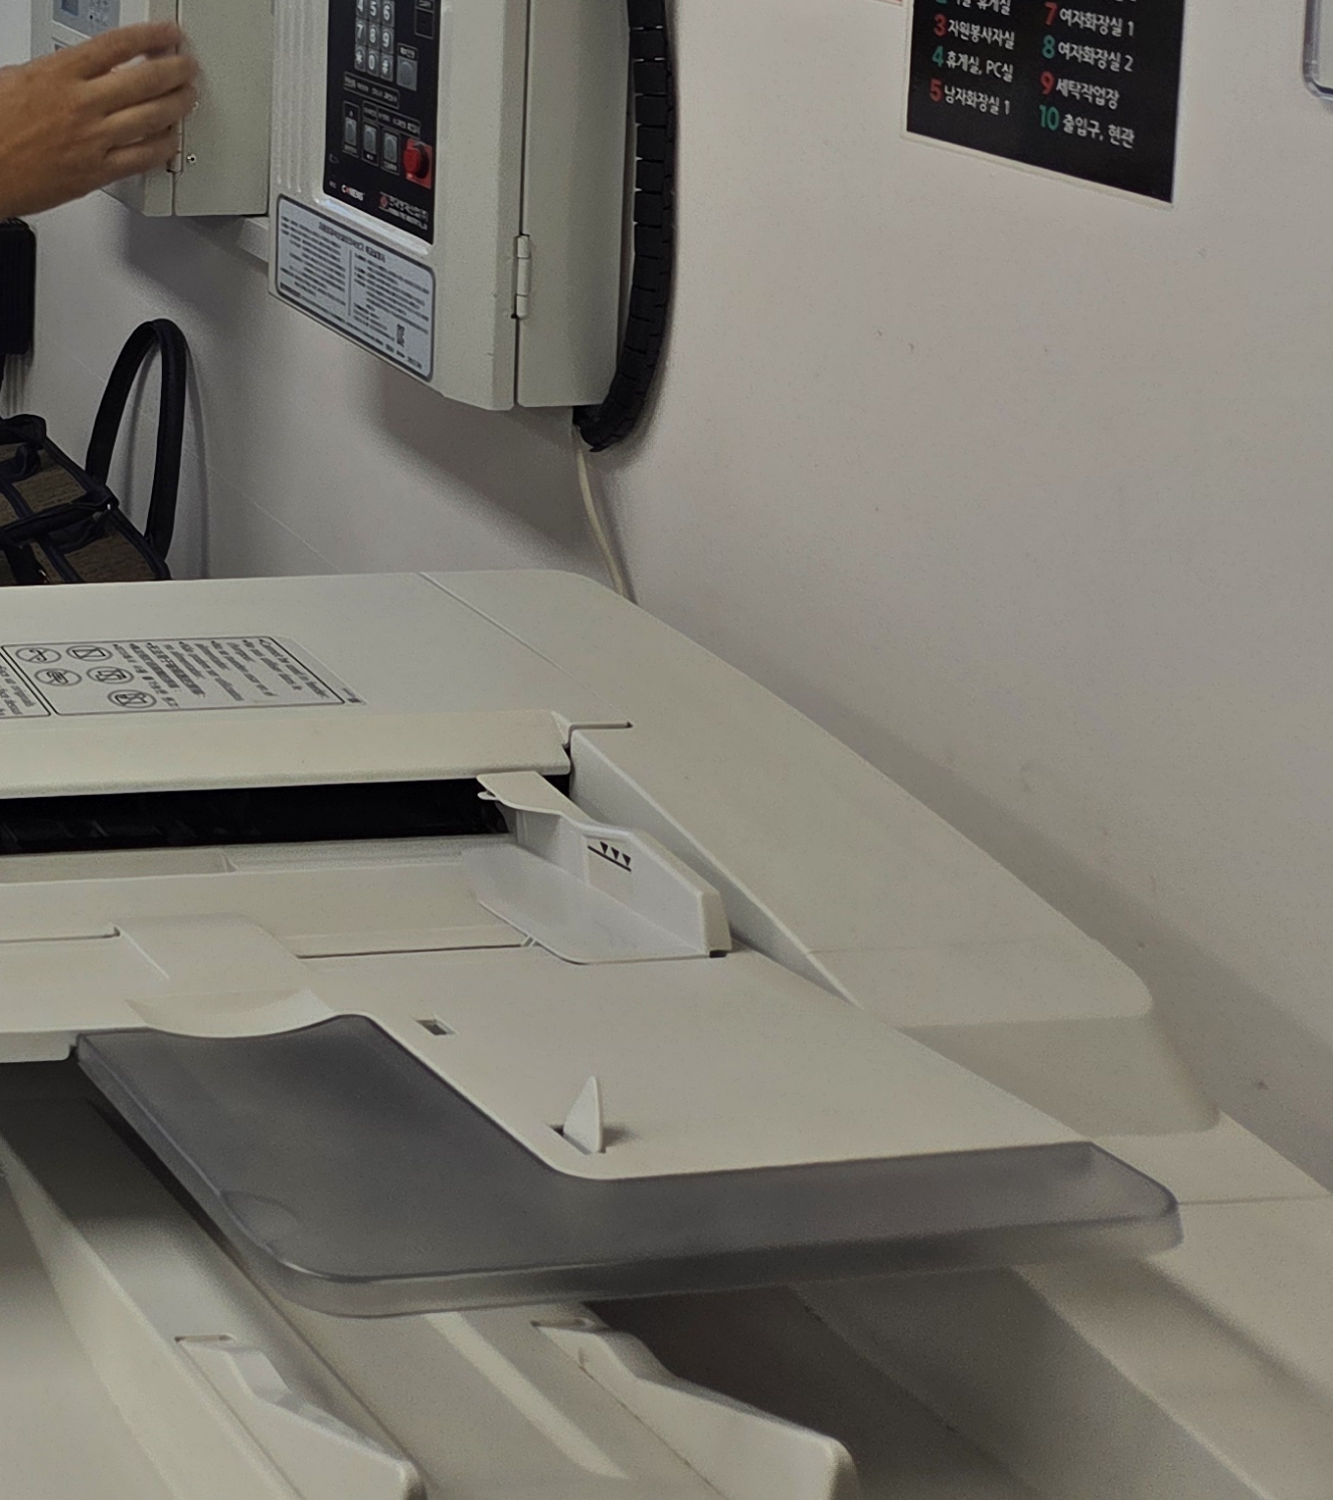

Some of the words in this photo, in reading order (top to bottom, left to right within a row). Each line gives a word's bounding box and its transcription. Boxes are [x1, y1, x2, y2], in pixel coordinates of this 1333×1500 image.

[370, 1, 377, 16] 5
[384, 4, 391, 20] 6
[1044, 2, 1058, 26] 7
[1059, 7, 1123, 38] 여자화장실
[1127, 21, 1135, 38] 1
[357, 23, 363, 39] 7
[369, 28, 376, 42] 8
[383, 32, 390, 47] 9
[934, 13, 947, 37] 3
[947, 19, 1015, 50] 자원봉사자실
[368, 54, 375, 69] 0
[932, 46, 944, 68] 4
[986, 61, 1014, 83] PC실
[1042, 35, 1056, 59] 8
[1057, 41, 1121, 73] 여자화장실
[1124, 54, 1134, 73] 2
[929, 79, 943, 102] 5
[944, 84, 1000, 116] 남자화장실
[1004, 100, 1011, 115] 1
[1039, 71, 1055, 95] 9
[1056, 78, 1120, 111] 세탁작업장
[1039, 104, 1060, 131] 10
[1107, 123, 1135, 149] 현관
